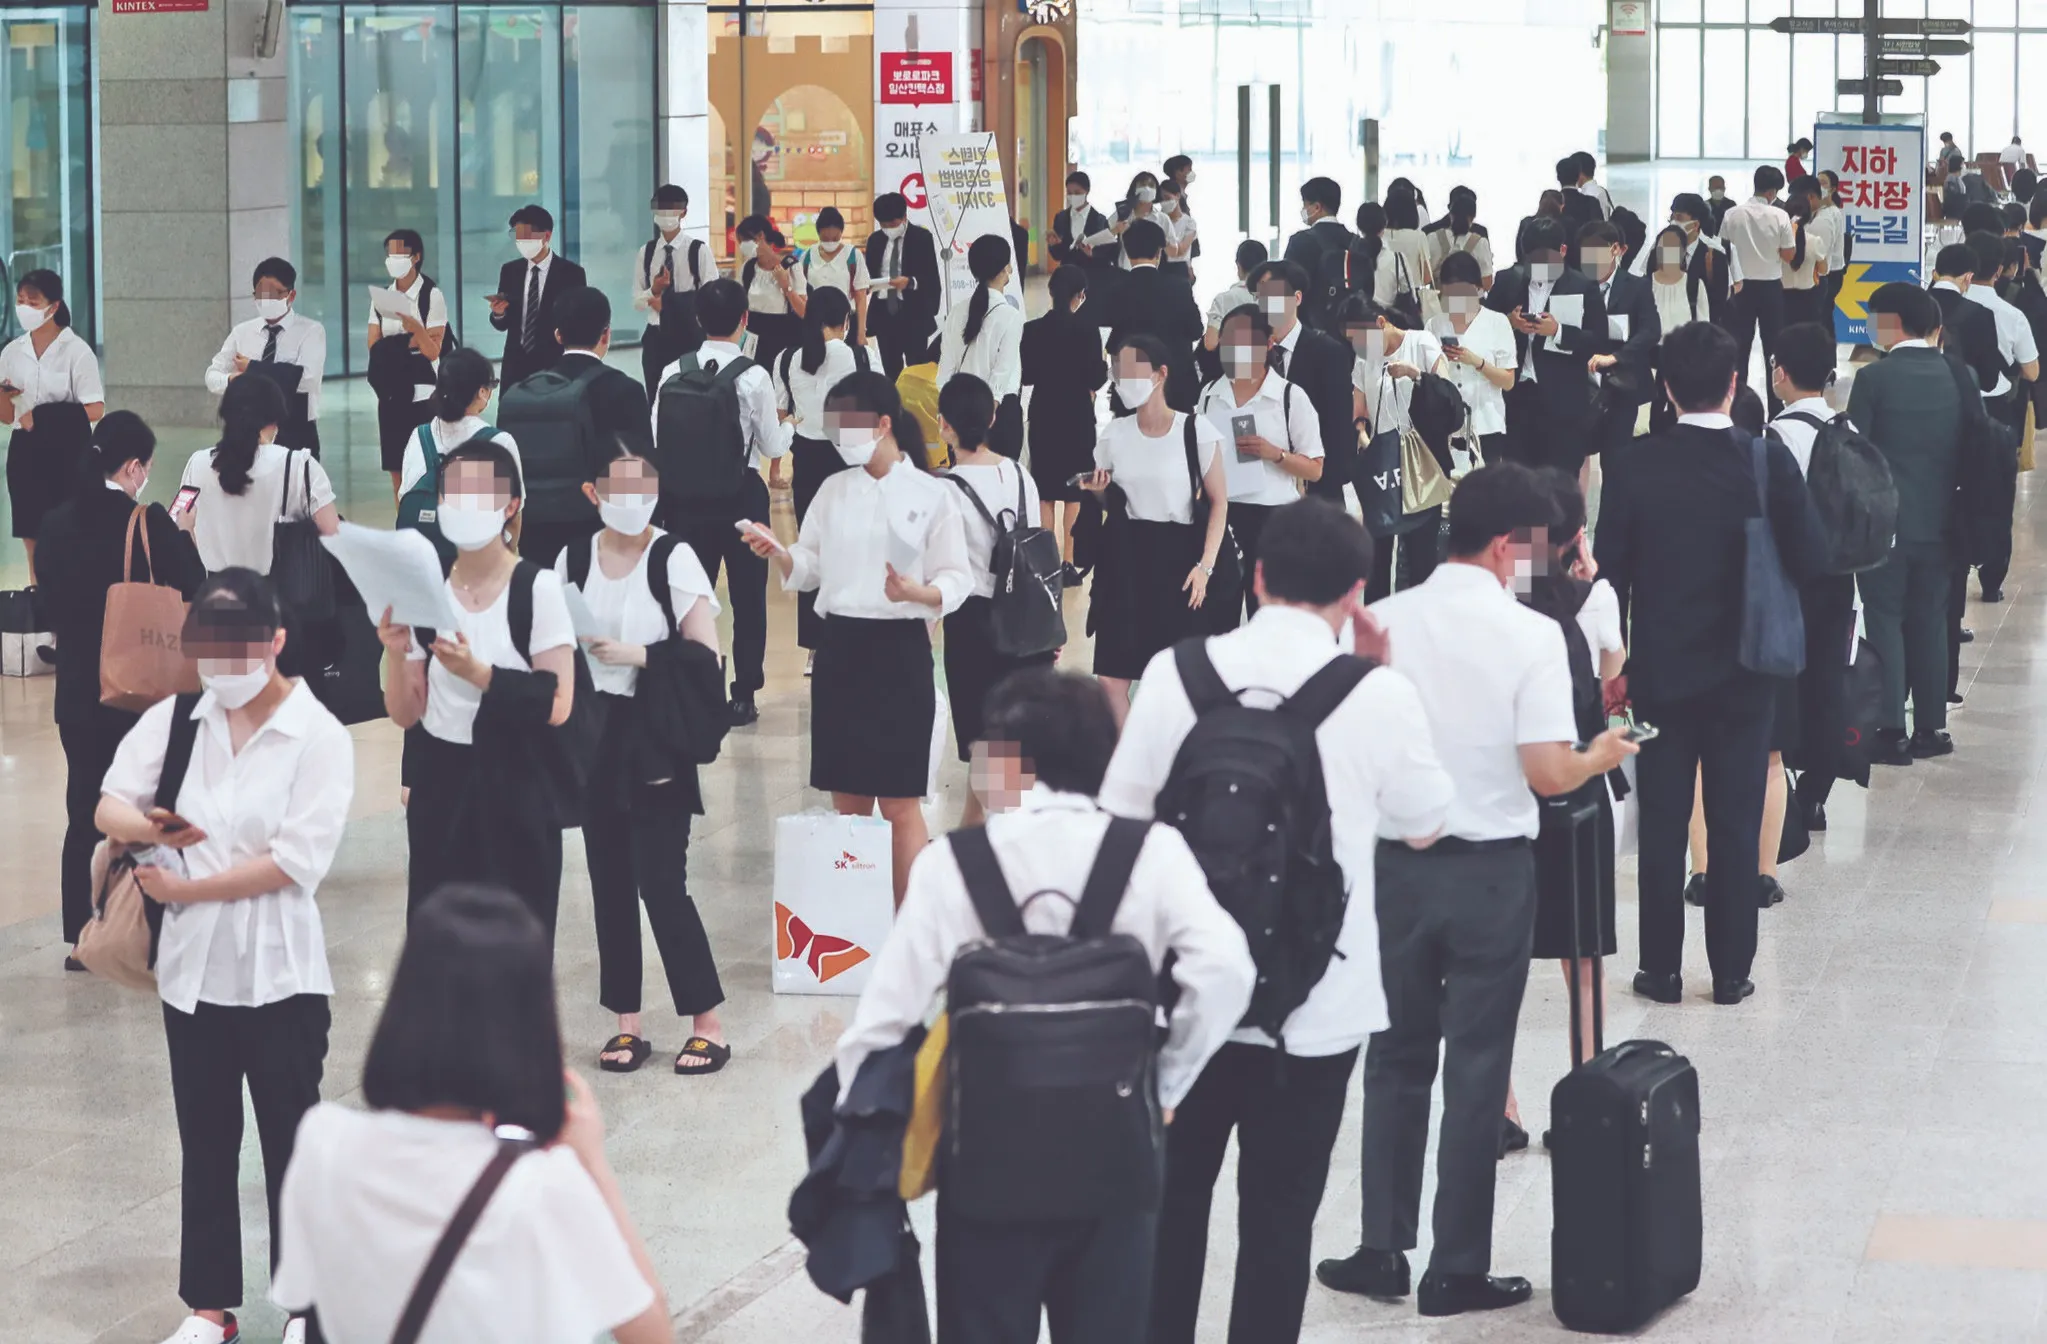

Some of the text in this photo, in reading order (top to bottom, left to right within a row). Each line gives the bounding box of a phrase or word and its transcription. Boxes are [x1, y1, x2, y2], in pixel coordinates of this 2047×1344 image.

[116, 2, 156, 11] KINTEX
[1841, 145, 1898, 176] 지하
[1837, 179, 1911, 211] 주차장
[140, 628, 181, 651] HAZ
[834, 860, 847, 870] SK
